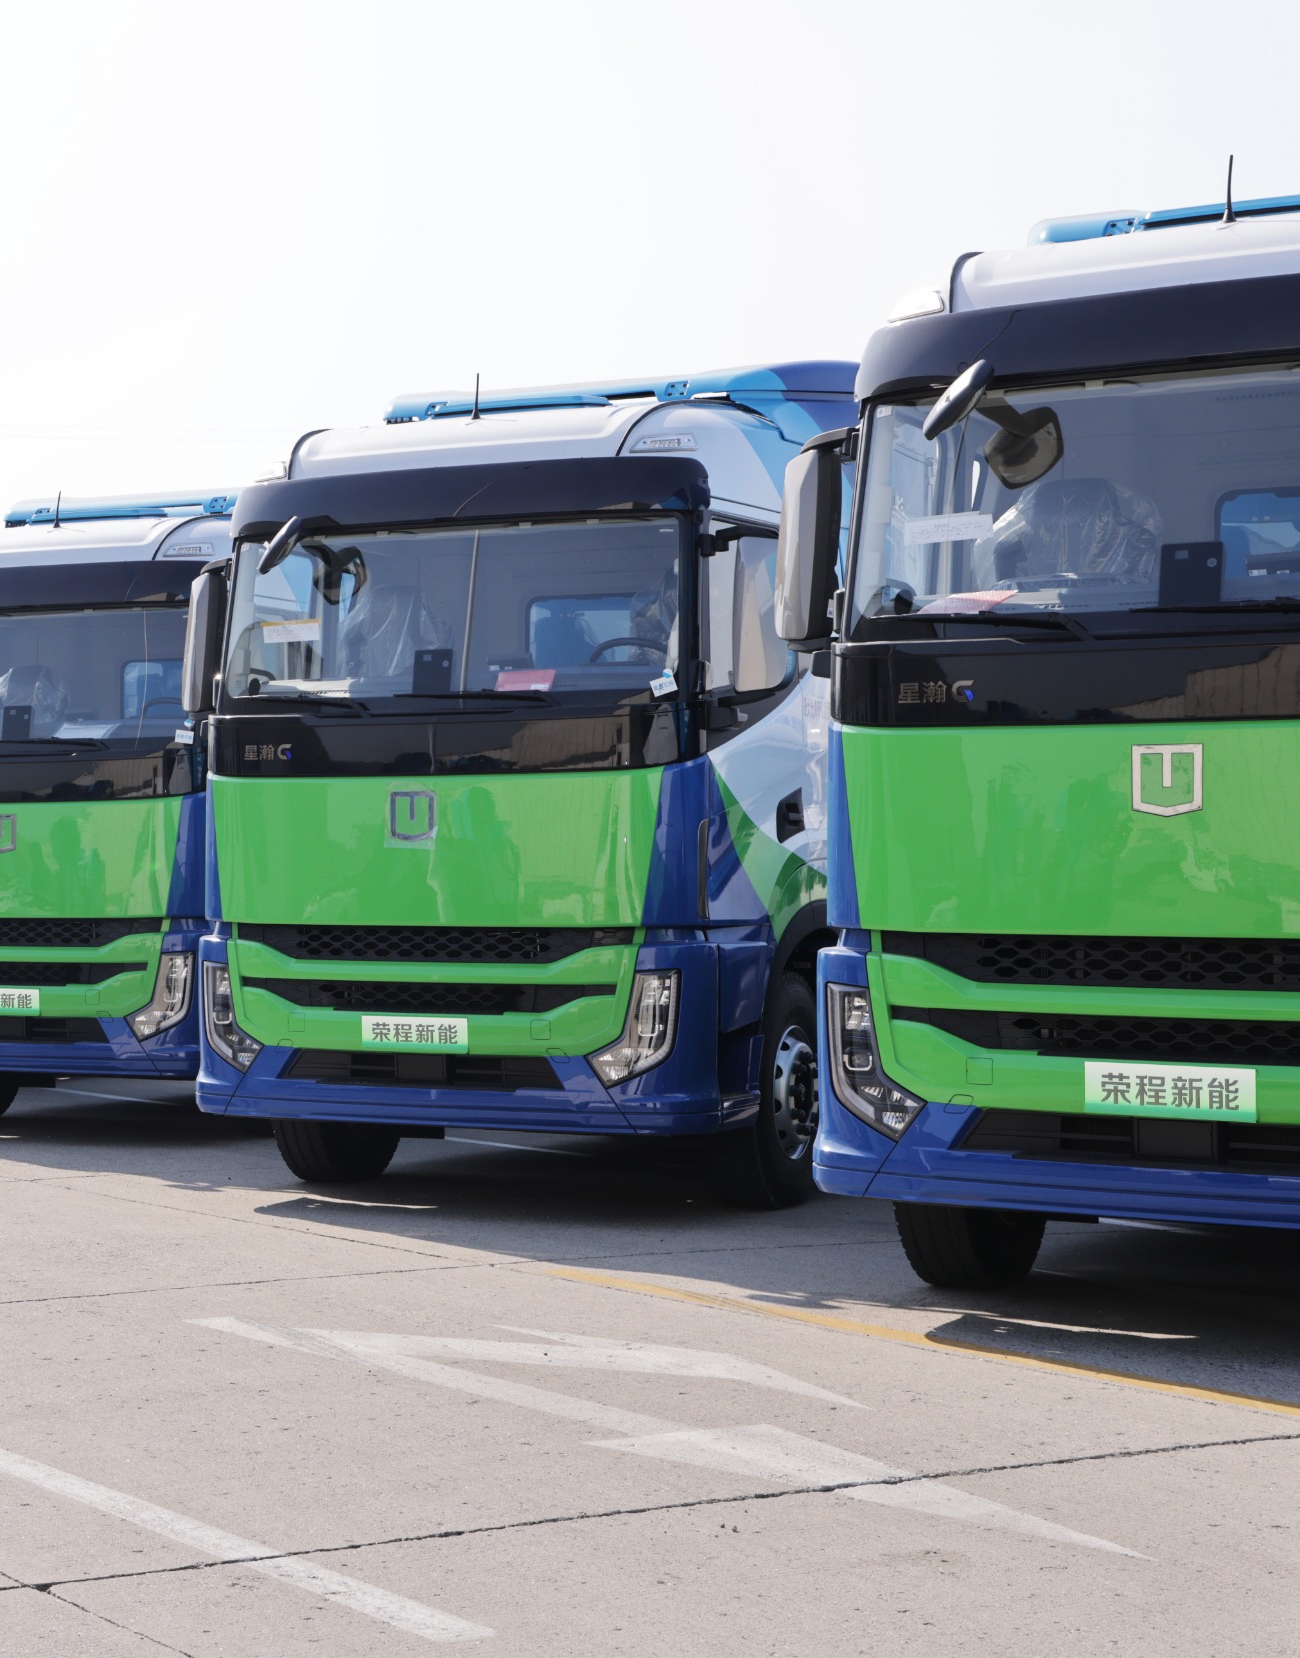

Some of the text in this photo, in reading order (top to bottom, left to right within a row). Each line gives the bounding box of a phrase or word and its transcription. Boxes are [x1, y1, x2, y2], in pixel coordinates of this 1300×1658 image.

[371, 1021, 458, 1044] 荣程新能
[1100, 1072, 1240, 1110] 荣程新能
